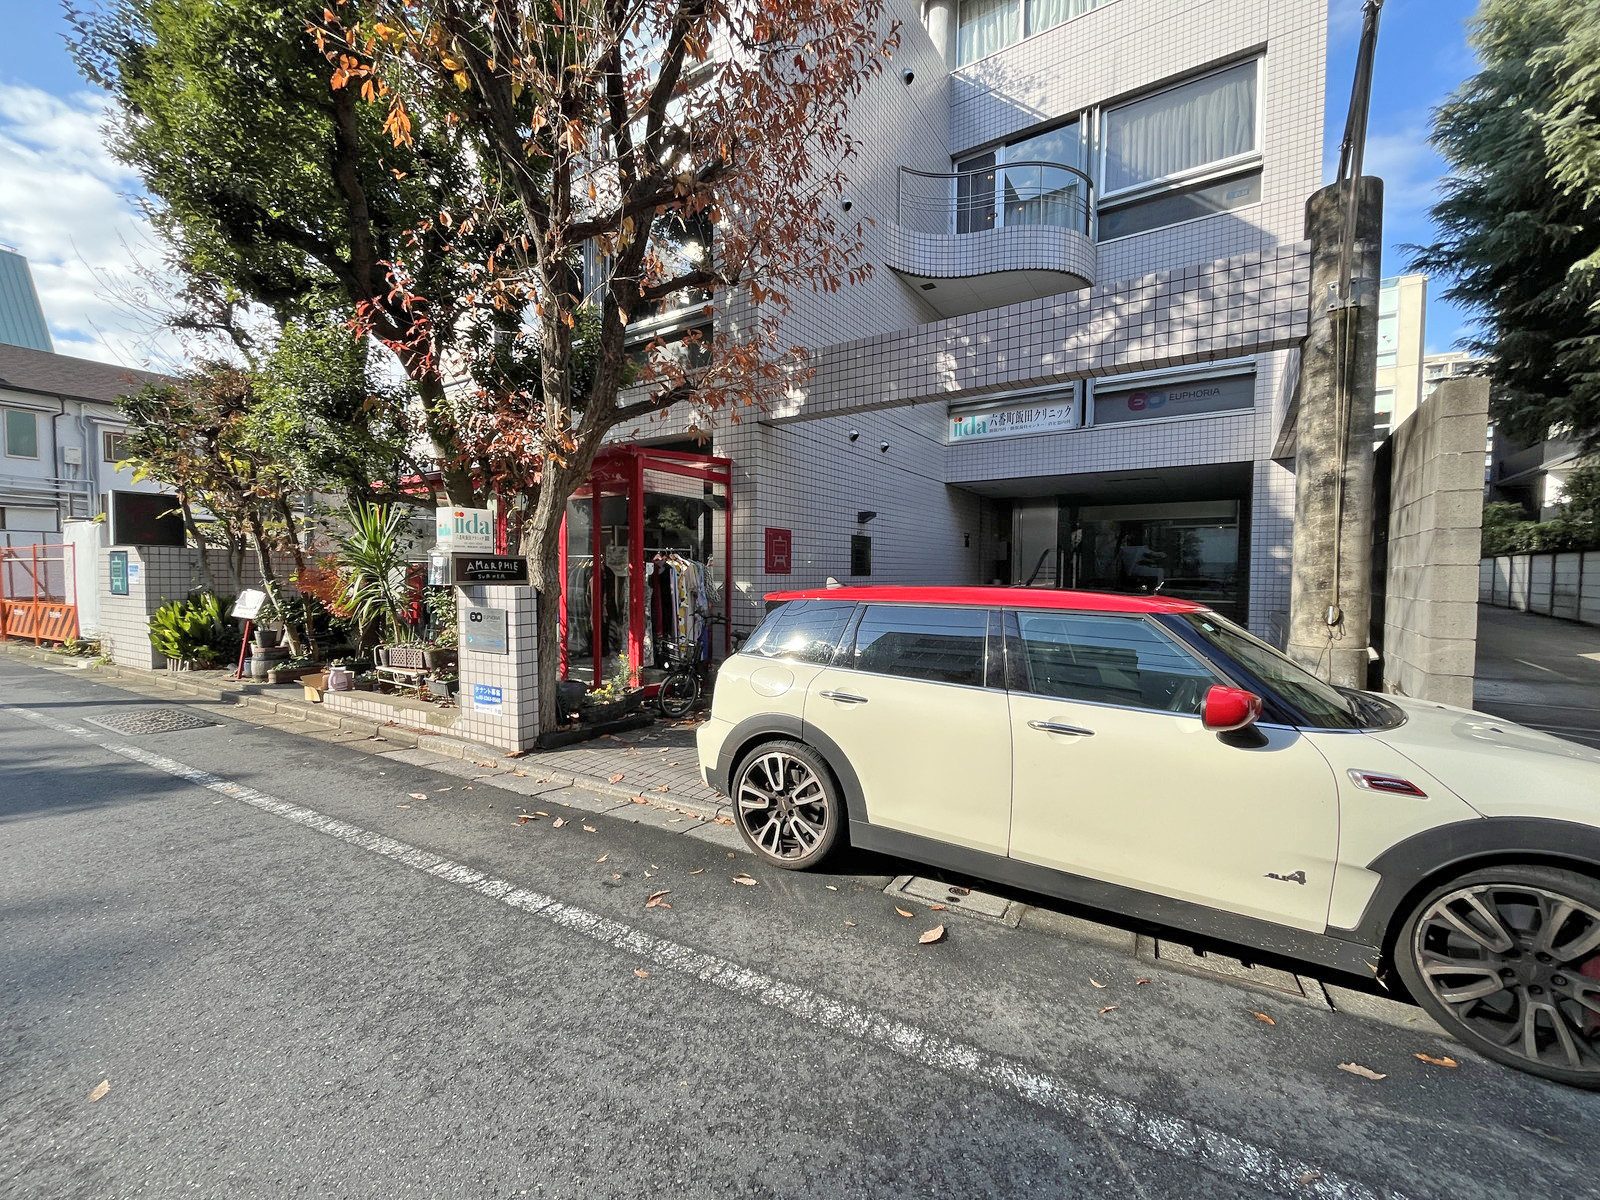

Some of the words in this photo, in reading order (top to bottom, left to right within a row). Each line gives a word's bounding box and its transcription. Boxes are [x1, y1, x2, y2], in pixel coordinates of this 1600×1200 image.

[1169, 388, 1220, 401] EUPHORIA
[989, 405, 1072, 426] 六番町飯田クリニック
[953, 416, 987, 438] iida
[454, 512, 491, 535] iida
[475, 686, 501, 697] テナント募集
